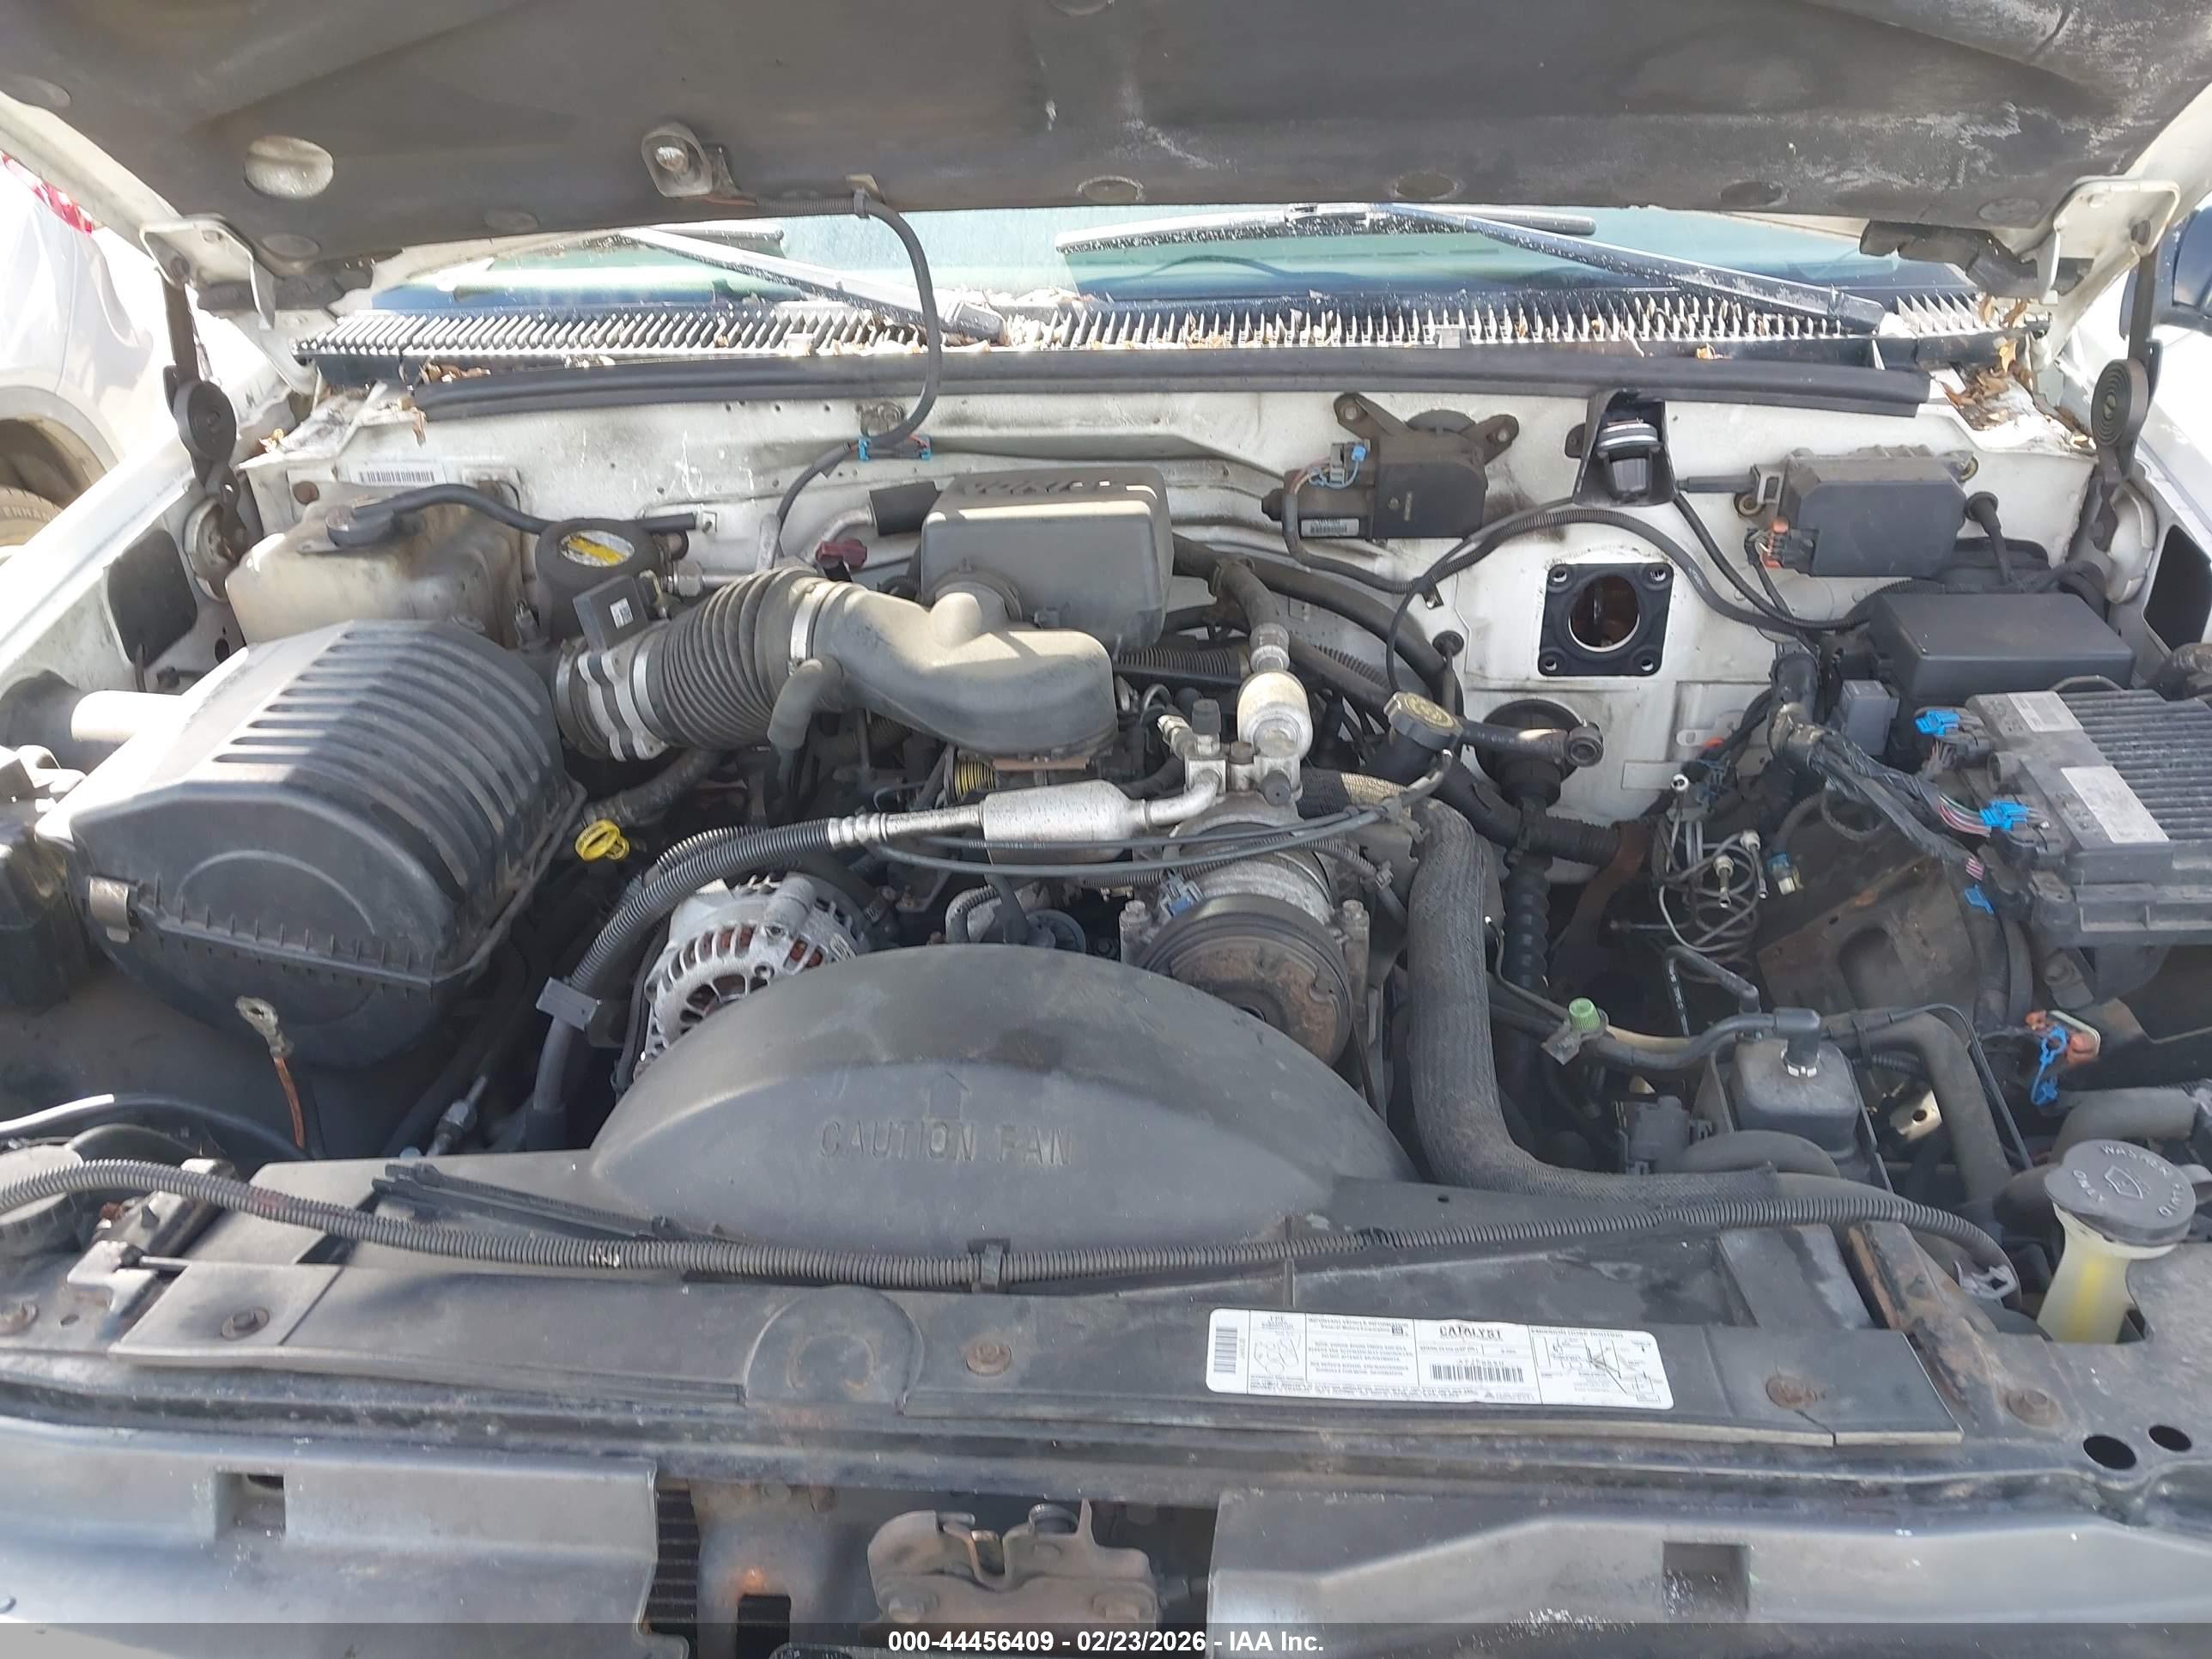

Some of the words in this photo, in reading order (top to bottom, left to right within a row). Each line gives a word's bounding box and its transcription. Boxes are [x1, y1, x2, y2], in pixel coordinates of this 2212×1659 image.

[819, 1120, 975, 1162] CAUTION
[997, 1124, 1073, 1166] FAN
[1439, 1324, 1504, 1340] CATALYST
